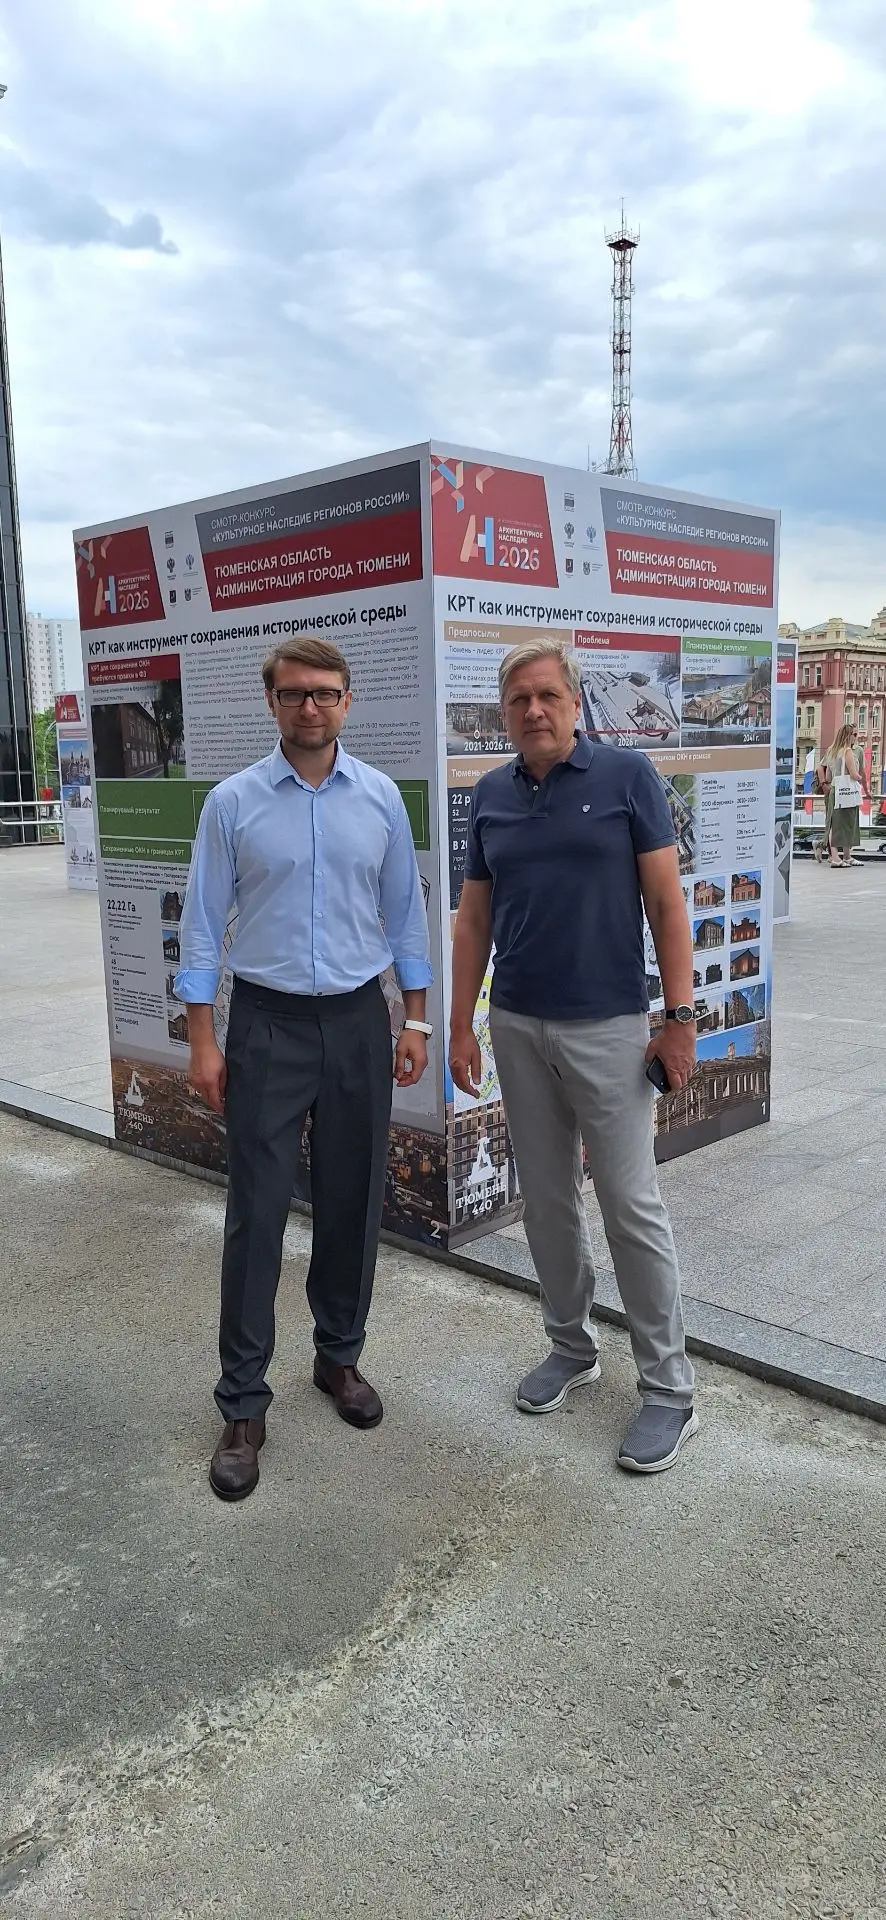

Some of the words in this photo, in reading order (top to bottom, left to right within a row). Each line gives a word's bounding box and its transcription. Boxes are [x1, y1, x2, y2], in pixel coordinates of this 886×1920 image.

[211, 506, 276, 530] СМОТР-КОНКУРС
[212, 523, 265, 543] «КУЛЬТУРНОЕ
[267, 512, 312, 532] НАСЛЕДИЕ
[314, 500, 362, 523] РЕГИОНОВ
[364, 491, 410, 511] РОССИИ»
[616, 500, 677, 520] СМОТР-КОНКУРС
[499, 526, 544, 539] АРХИТЕКТУРНОЕ
[616, 514, 666, 532] «КУЛЬТУРНОЕ
[668, 522, 704, 537] НАСЛЕДИЕ
[705, 528, 740, 542] РЕГИОНОВ
[741, 534, 769, 547] РОССИИ»
[499, 535, 528, 544] НАСЛЕДИЕ
[214, 557, 278, 579] ТЮМЕНСКАЯ
[280, 546, 331, 567] ОБЛАСТЬ
[499, 545, 540, 570] 2026
[616, 548, 675, 567] ТЮМЕНСКАЯ
[677, 556, 717, 572] ОБЛАСТЬ
[216, 571, 304, 599] АДМИНИСТРАЦИЯ
[308, 563, 353, 583] ГОРОДА
[356, 552, 410, 575] ТЮМЕНИ
[616, 569, 696, 589] АДМИНИСТРАЦИЯ
[698, 578, 731, 593] ГОРОДА
[733, 581, 767, 596] ТЮМЕНИ
[119, 590, 150, 612] 2026
[447, 594, 475, 612] КРТ
[479, 601, 502, 615] как
[506, 603, 583, 623] инструмент
[586, 610, 655, 627] сохранения
[658, 616, 730, 632] исторической
[733, 622, 763, 636] среды
[89, 640, 106, 656] КРТ
[108, 642, 125, 653] как
[127, 633, 188, 652] инструмент
[191, 624, 260, 645] сохранения
[262, 607, 356, 636] исторической
[360, 604, 407, 626] среды
[448, 627, 500, 639] Предпосылки
[577, 635, 610, 645] Проблема
[686, 641, 723, 651] Планируемый
[724, 644, 747, 652] результат
[449, 646, 471, 654] Тюмень
[464, 741, 503, 751] 2021-2026
[618, 738, 633, 746] 2026
[452, 769, 480, 777] Тюмень
[452, 794, 462, 805] 22
[100, 806, 134, 814] Планируемый
[135, 808, 160, 816] результат
[453, 841, 458, 850] В
[107, 899, 126, 911] 22,22
[128, 901, 136, 912] Га
[118, 1107, 154, 1124] ТЮМЕНЬ
[762, 1101, 766, 1115] 1
[128, 1120, 143, 1131] 440
[456, 1184, 507, 1208] ТЮМЕНЬ
[472, 1199, 492, 1216] 440
[430, 1222, 441, 1239] 2
